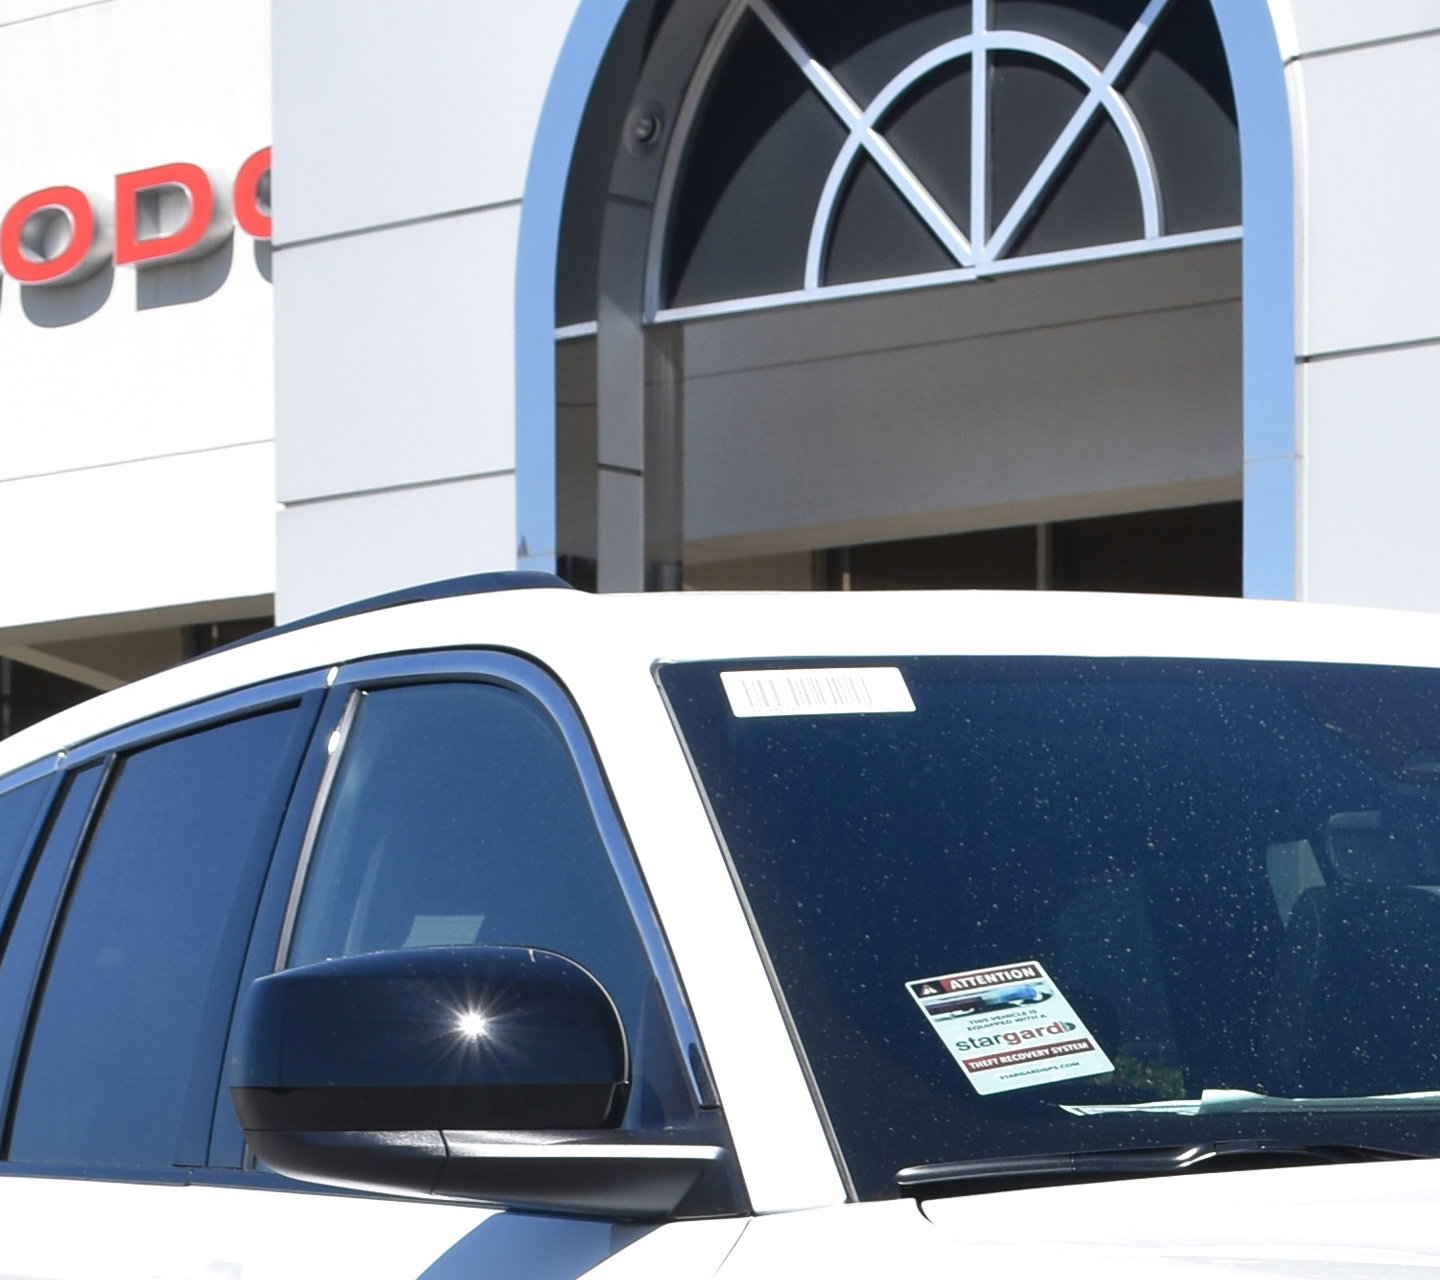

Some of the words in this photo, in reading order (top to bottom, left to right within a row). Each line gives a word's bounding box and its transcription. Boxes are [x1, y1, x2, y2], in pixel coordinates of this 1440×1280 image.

[949, 966, 1036, 991] ATTENTION
[967, 1019, 1013, 1031] EQUIPPED
[1014, 1015, 1039, 1024] WITH
[969, 1017, 990, 1025] THIS
[991, 1011, 1026, 1022] VEHICLE
[969, 1056, 998, 1070] THEFT
[1000, 1047, 1050, 1065] RECOVERY
[1052, 1040, 1090, 1055] SYSTEM
